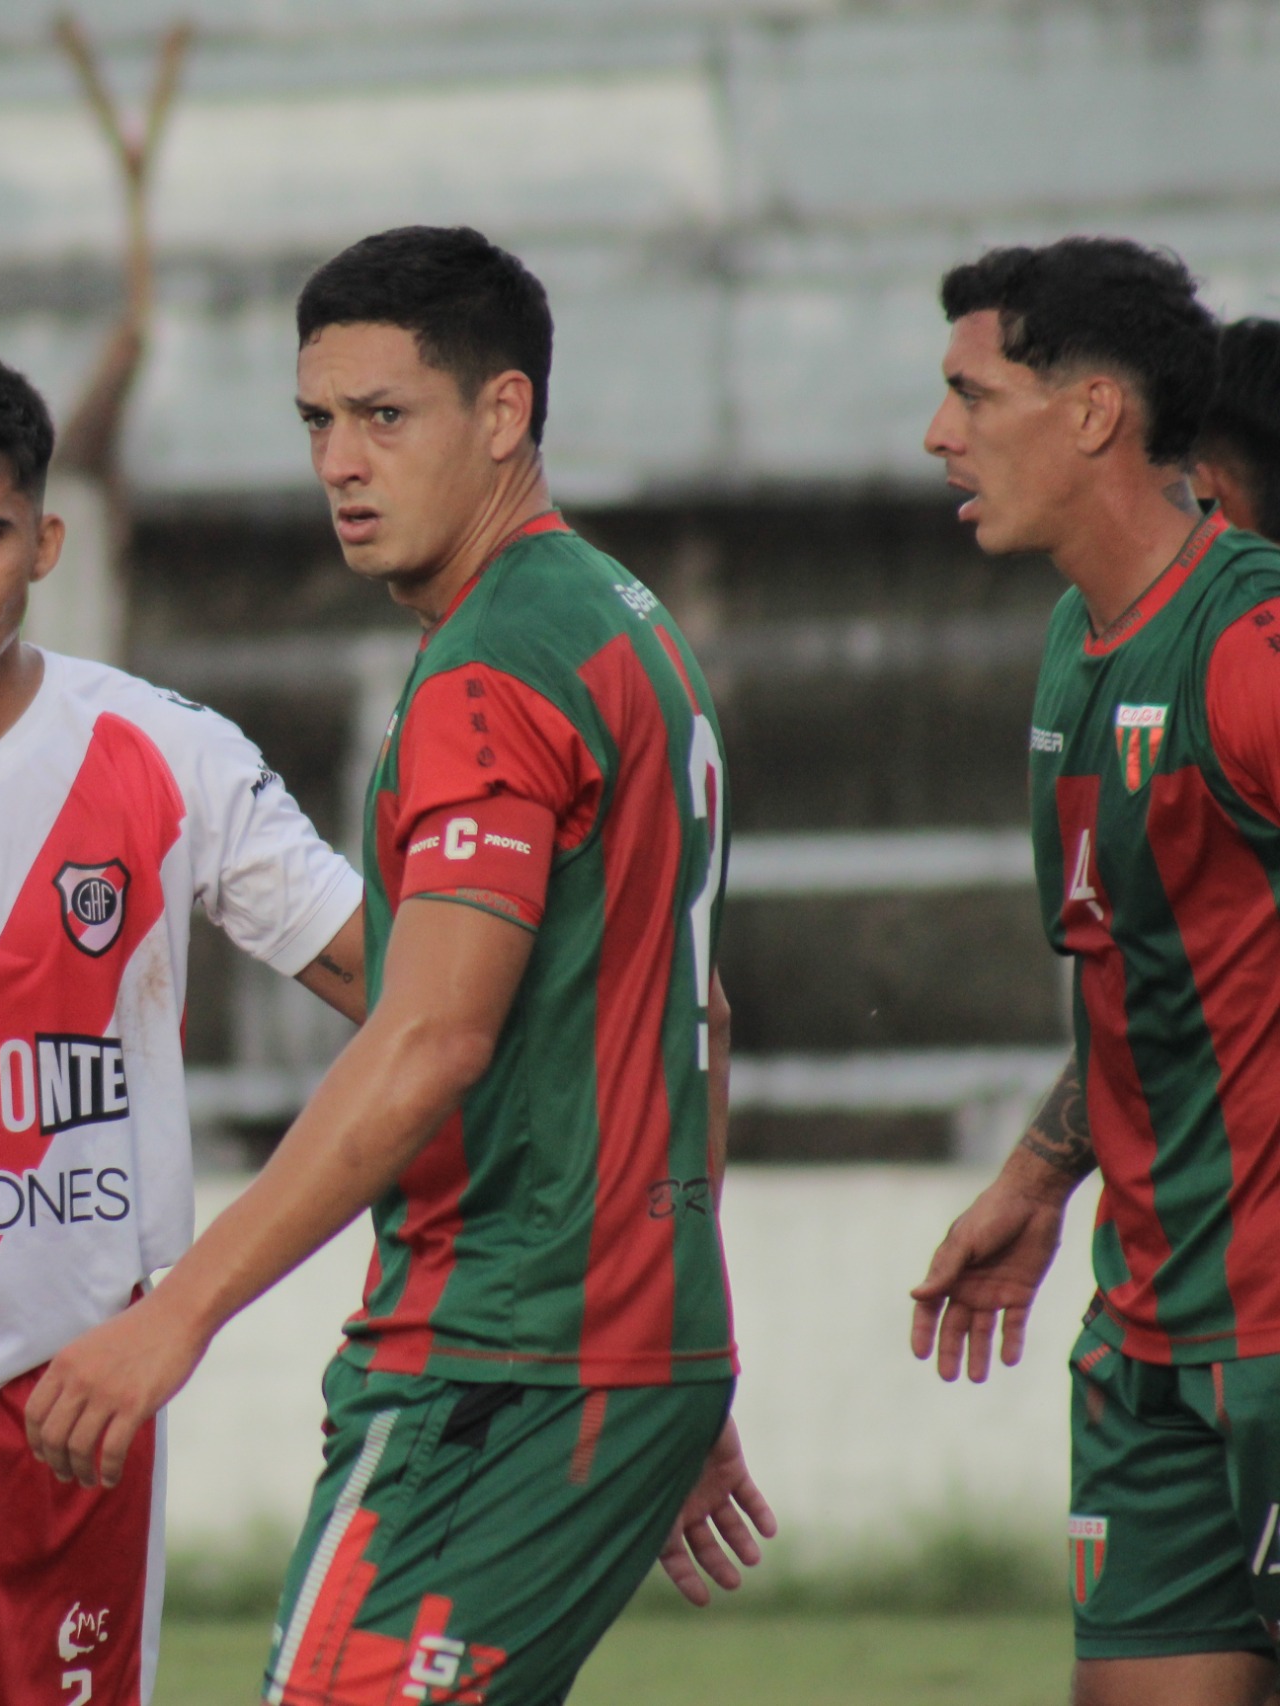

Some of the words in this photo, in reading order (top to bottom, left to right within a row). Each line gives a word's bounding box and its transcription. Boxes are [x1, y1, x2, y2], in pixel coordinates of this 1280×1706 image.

[444, 817, 478, 860] C
[484, 833, 531, 854] PROYEC
[77, 881, 113, 923] GAF
